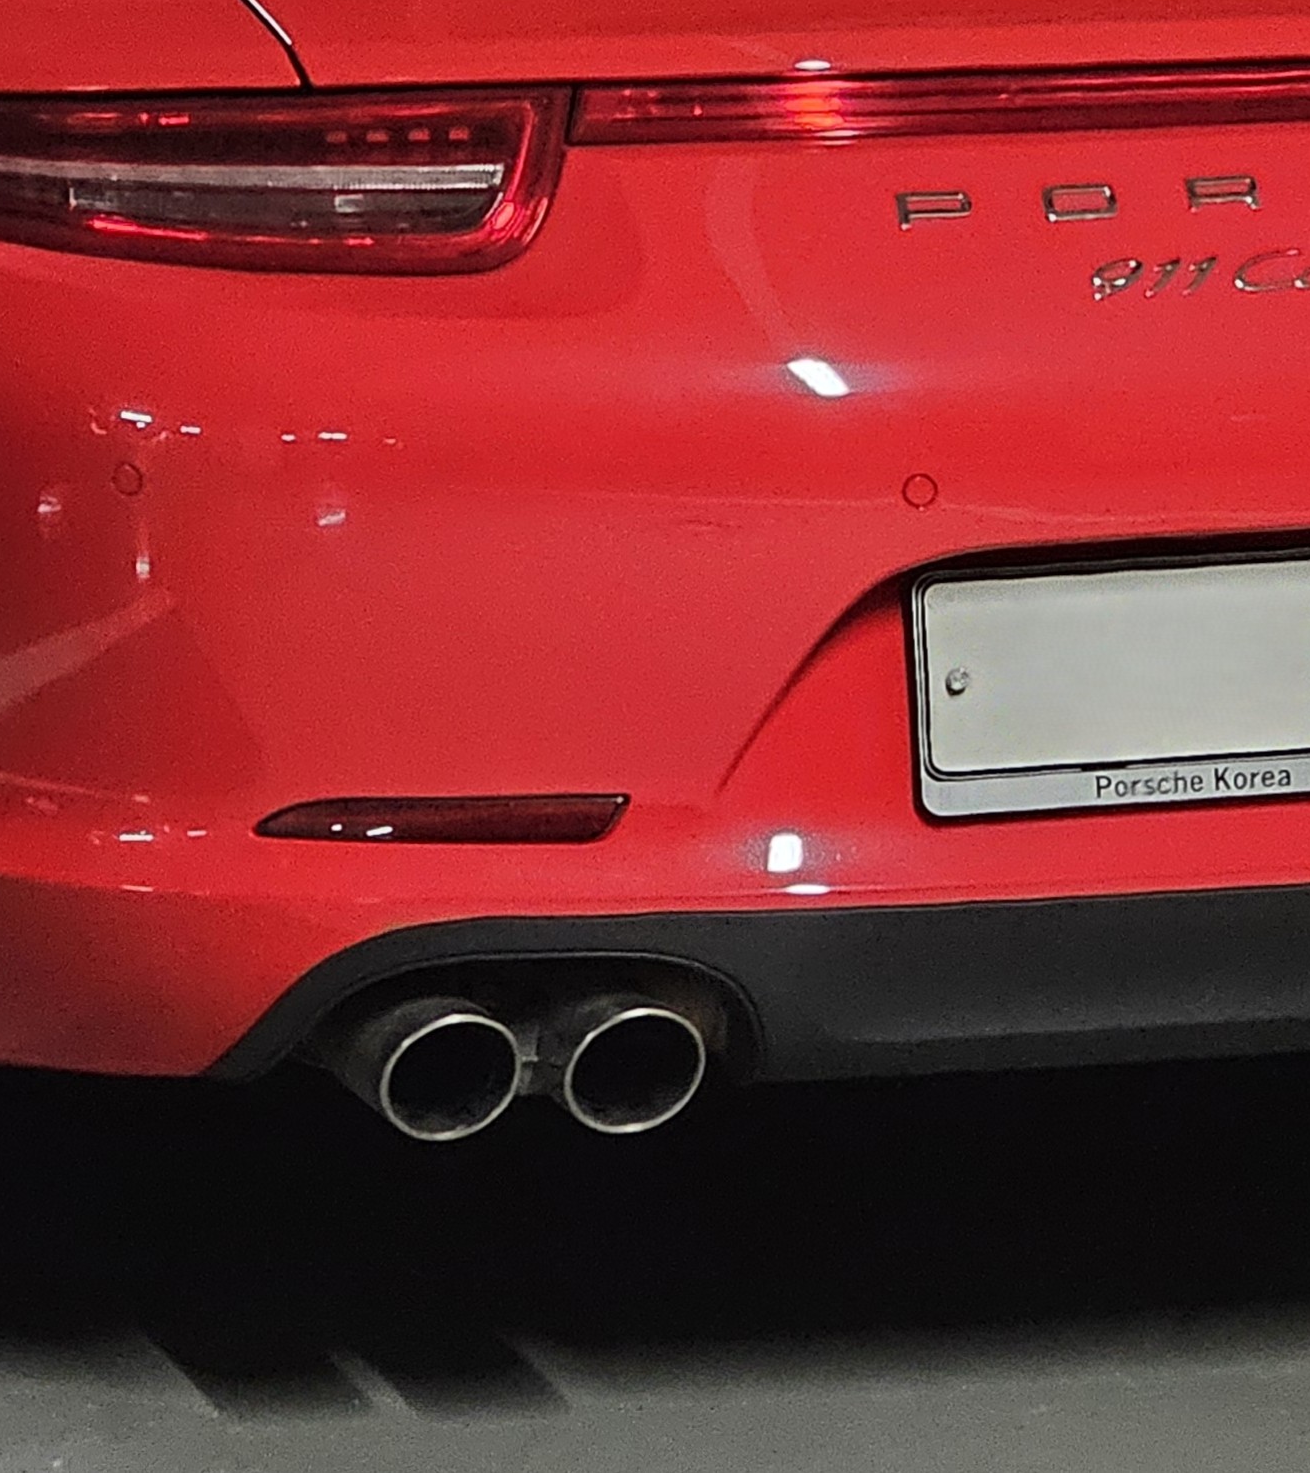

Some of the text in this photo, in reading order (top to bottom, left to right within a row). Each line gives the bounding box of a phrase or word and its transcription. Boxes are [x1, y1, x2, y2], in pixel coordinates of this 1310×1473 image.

[1091, 257, 1218, 301] 911
[1095, 769, 1204, 798] Porsche
[1213, 767, 1291, 792] Korea
